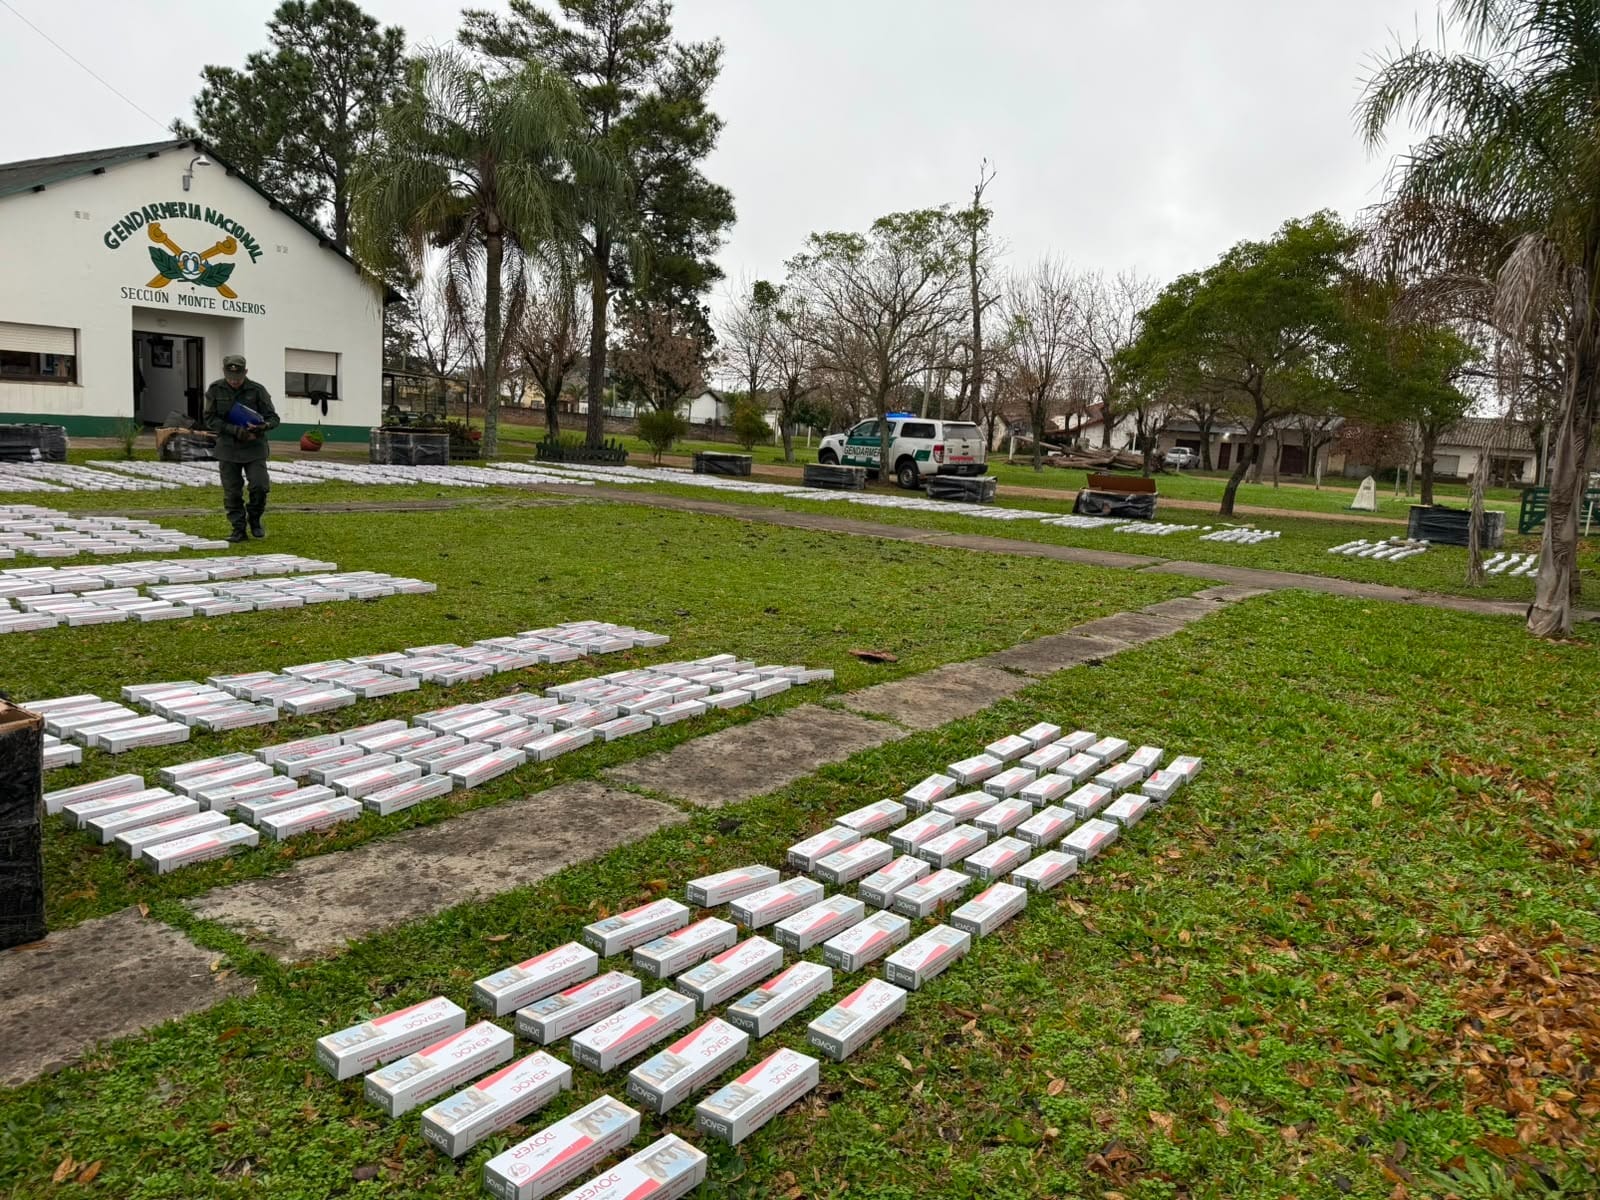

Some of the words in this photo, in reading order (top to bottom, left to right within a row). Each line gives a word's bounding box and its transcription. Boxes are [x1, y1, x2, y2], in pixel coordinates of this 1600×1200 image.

[103, 201, 202, 250] GENDARMERIA
[204, 206, 263, 264] NACIONAL
[178, 293, 216, 310] MONTE
[222, 299, 266, 315] CASEROS
[520, 1021, 540, 1037] DOVER
[451, 1036, 494, 1059] DOVER
[701, 1034, 733, 1057] DOVER
[510, 1069, 552, 1094] DOVER
[769, 1062, 802, 1085] DOVER
[631, 1082, 658, 1104] DOVER
[700, 1116, 728, 1135] DOVER
[424, 1126, 449, 1149] DOVER
[511, 1131, 558, 1159] DOVER
